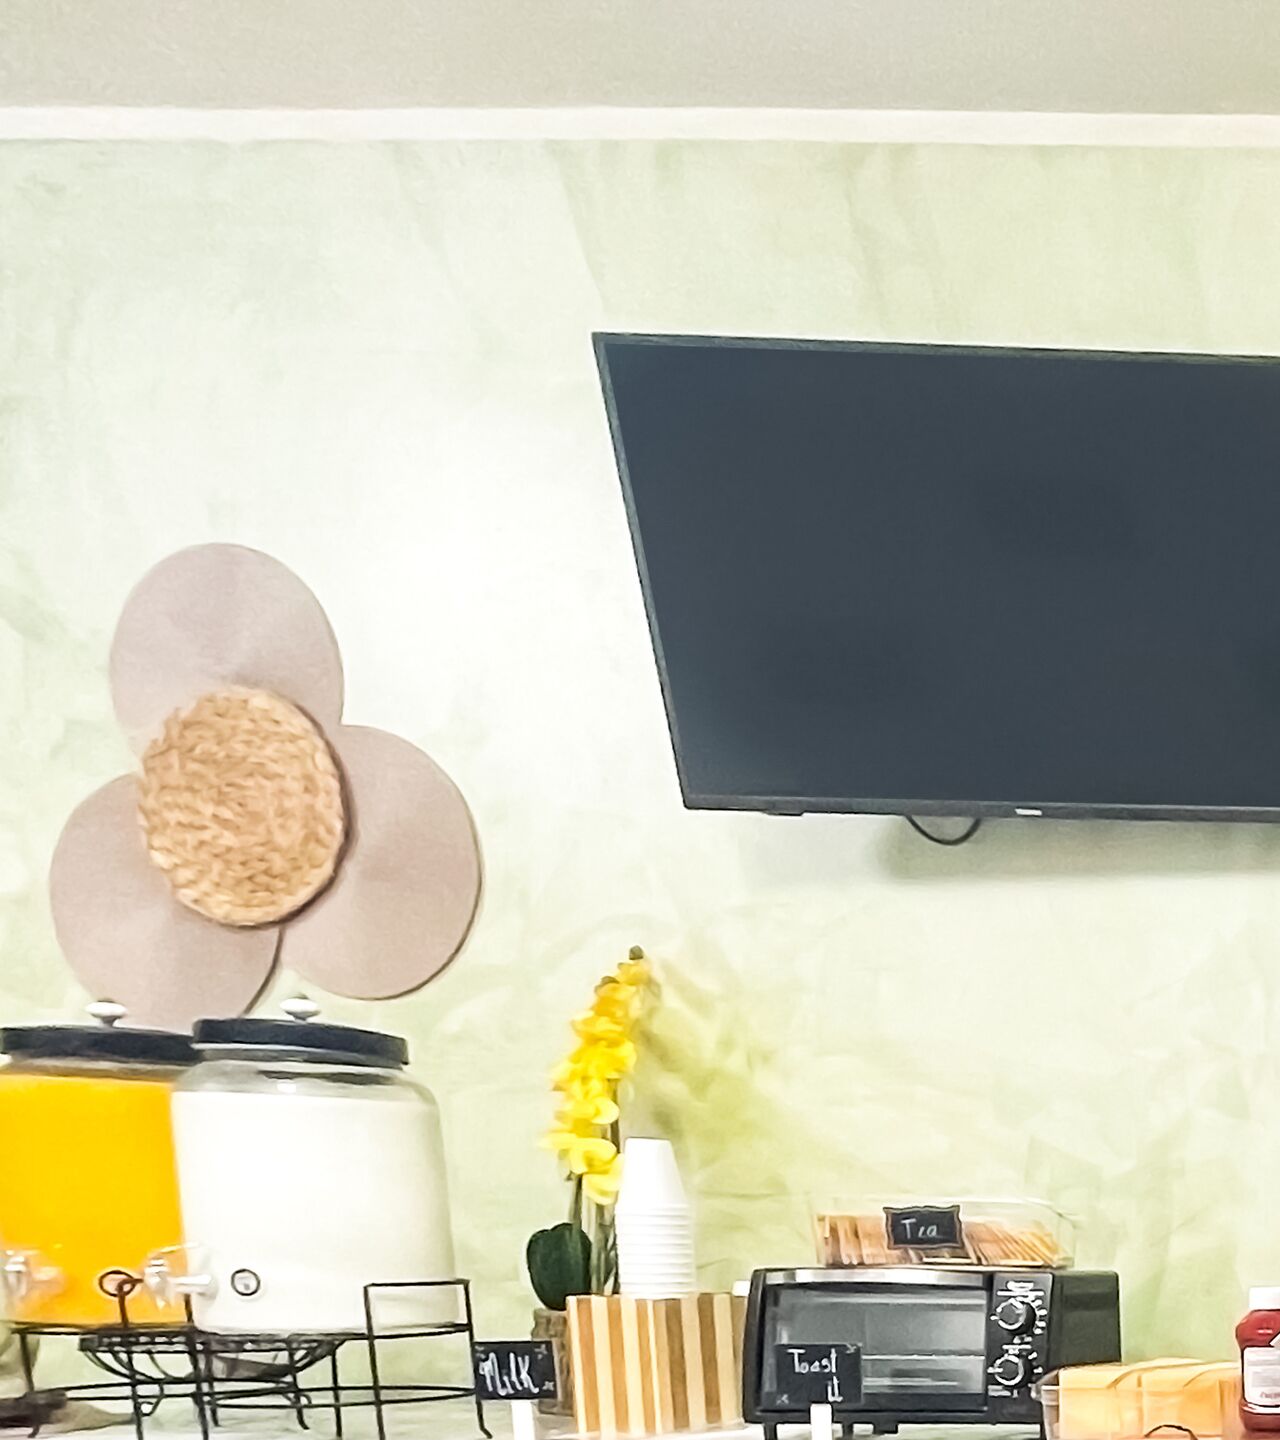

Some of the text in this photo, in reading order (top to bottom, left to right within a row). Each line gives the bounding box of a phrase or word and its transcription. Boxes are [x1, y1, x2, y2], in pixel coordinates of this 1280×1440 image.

[900, 1218, 938, 1240] Tea
[786, 1347, 837, 1374] Toast
[826, 1374, 844, 1403] it
